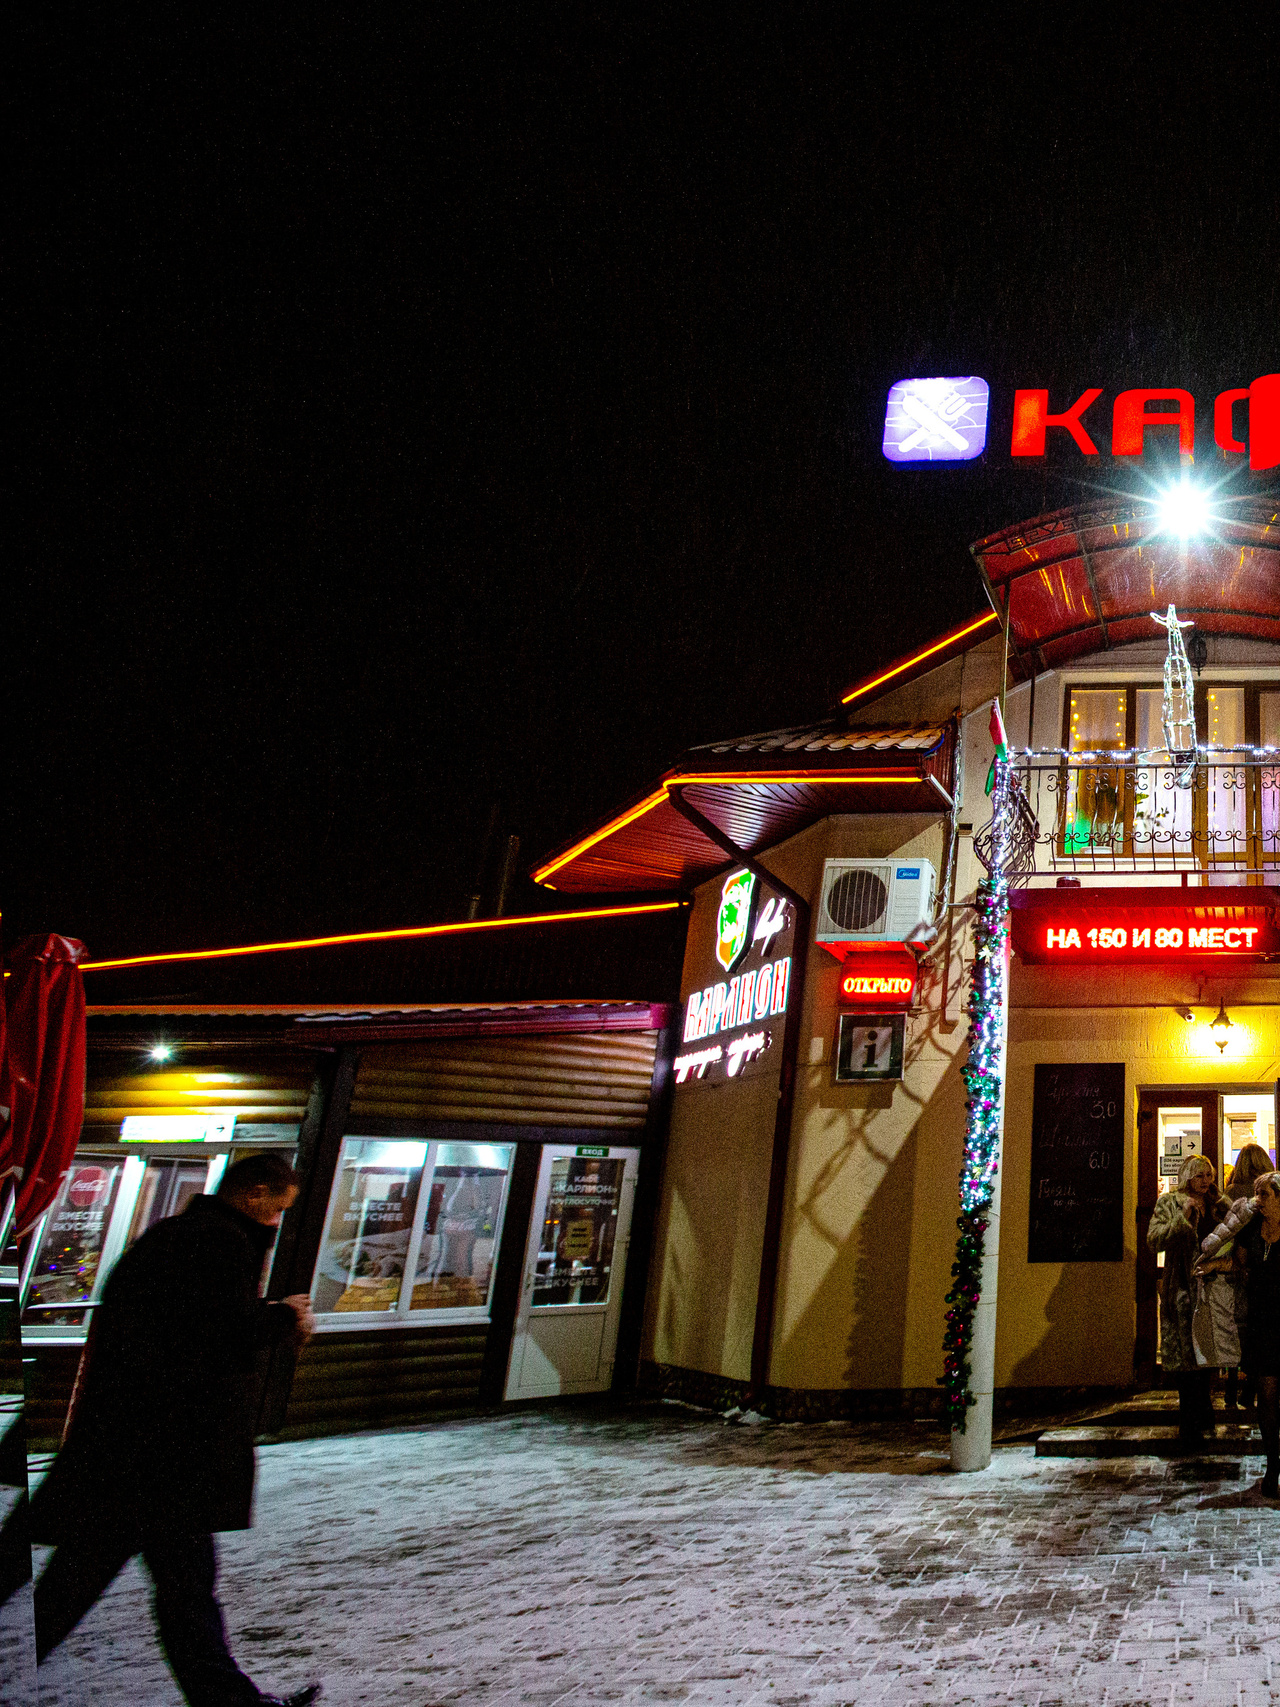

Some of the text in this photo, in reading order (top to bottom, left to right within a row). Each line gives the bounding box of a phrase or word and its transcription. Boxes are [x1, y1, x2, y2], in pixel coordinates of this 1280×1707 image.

[1046, 928, 1258, 948] НА 150 И 80 МЕСТ
[843, 977, 912, 993] ОТКРЫТО
[581, 1148, 604, 1156] ВХОД
